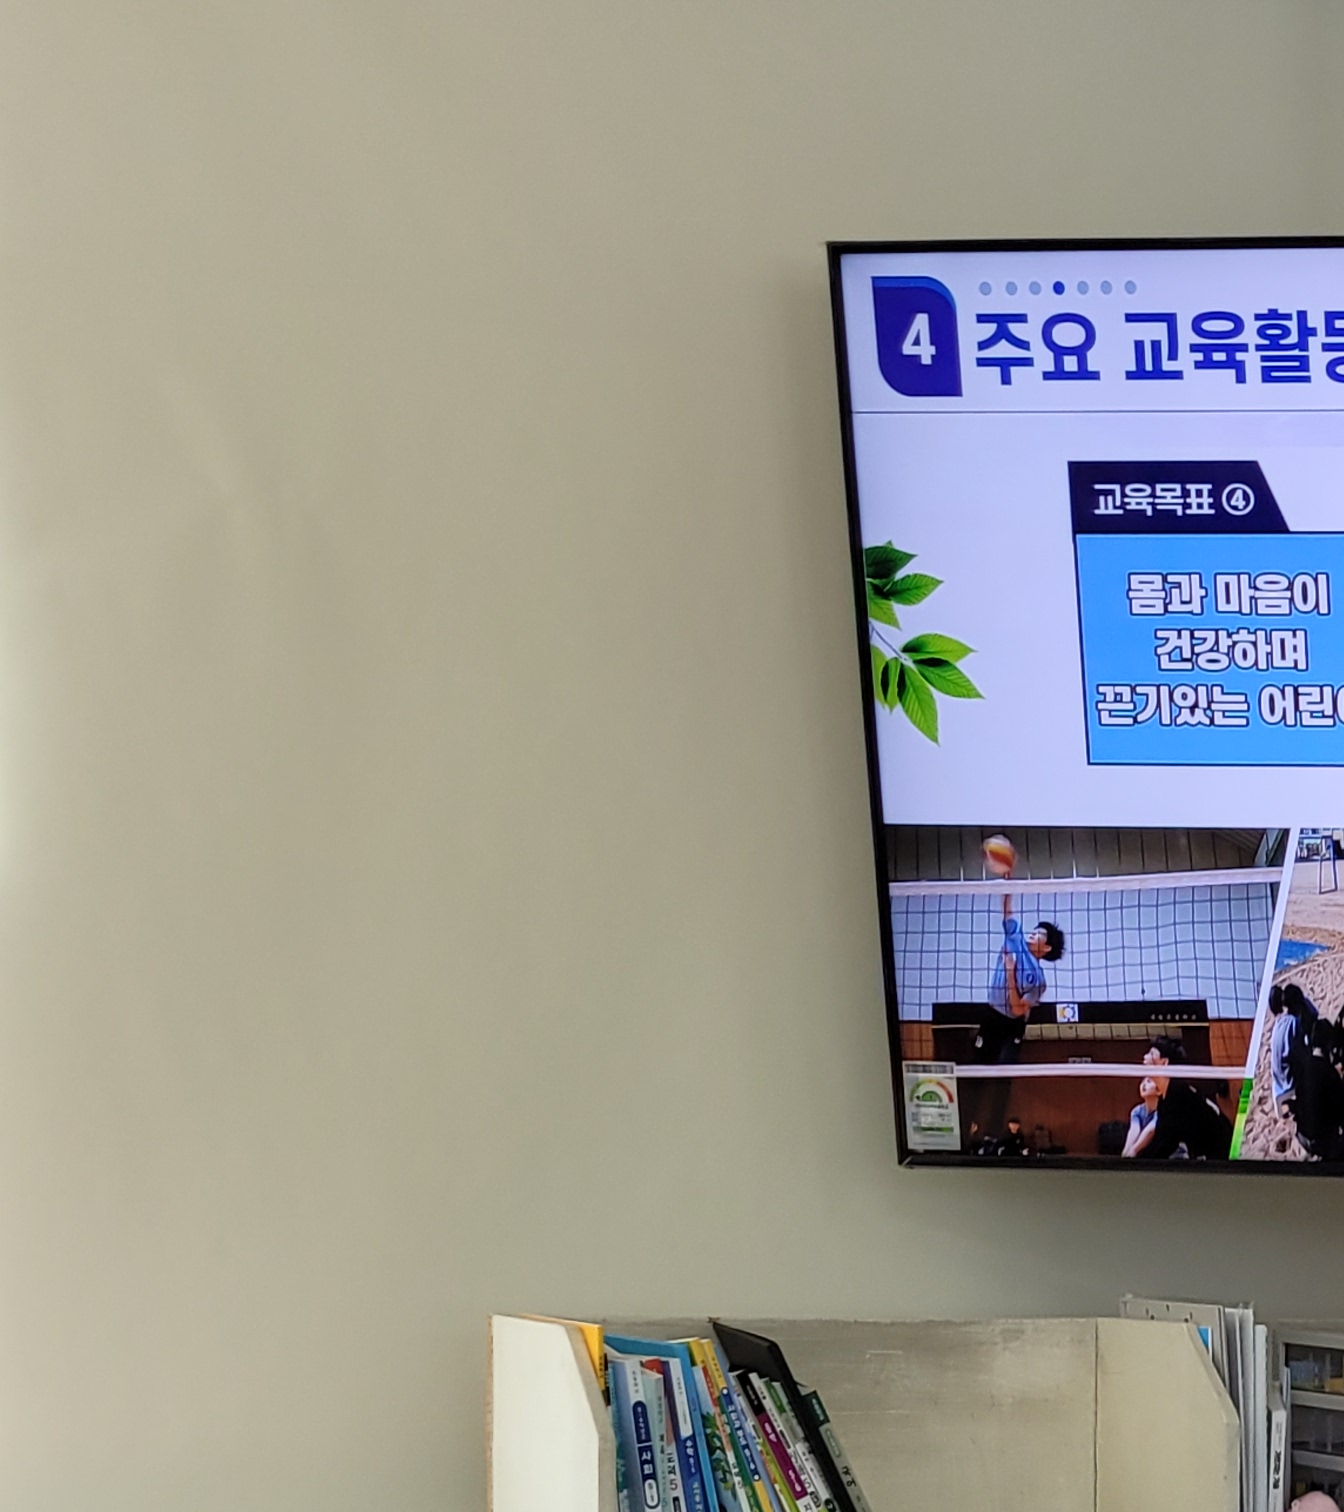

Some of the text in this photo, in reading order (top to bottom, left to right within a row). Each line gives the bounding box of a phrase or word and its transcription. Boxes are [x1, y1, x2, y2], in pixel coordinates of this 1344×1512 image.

[902, 313, 936, 365] 4
[975, 312, 1100, 386] 주요
[1093, 483, 1215, 516] 교육목표
[1127, 572, 1331, 616] 몸과 마음이
[1154, 627, 1309, 673] 건강하며
[1096, 683, 1250, 727] 끈기있는
